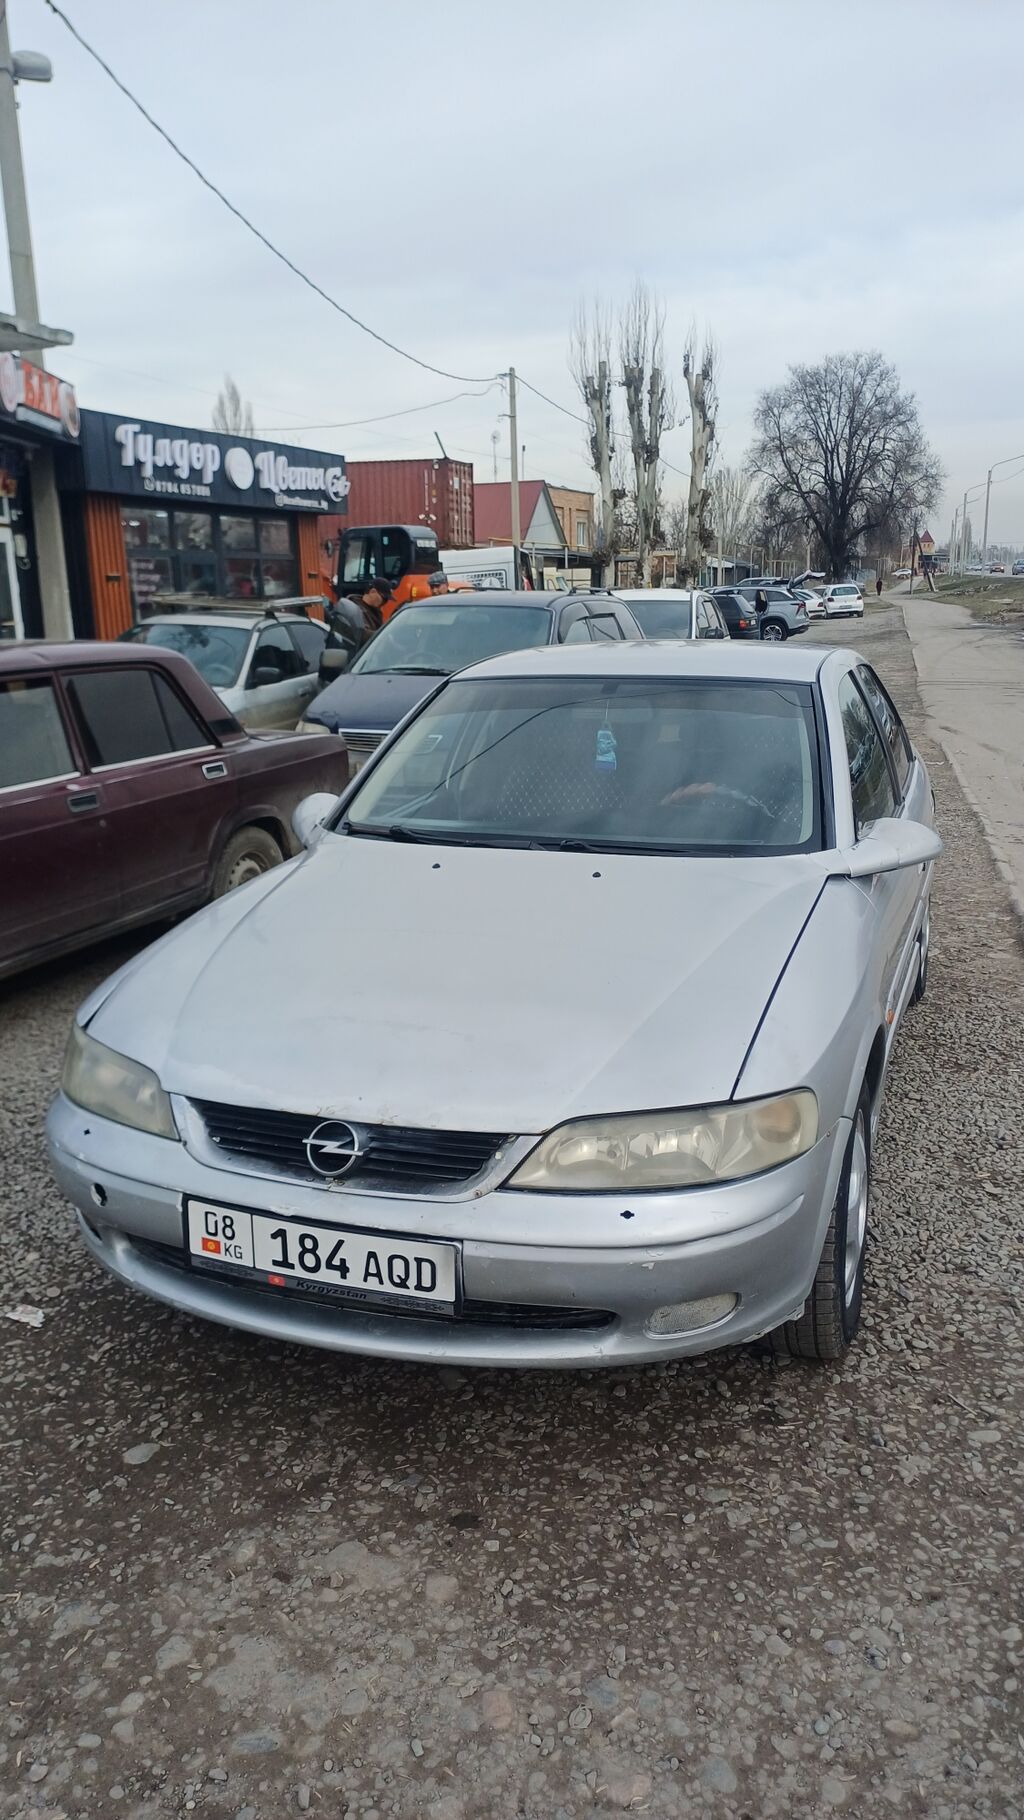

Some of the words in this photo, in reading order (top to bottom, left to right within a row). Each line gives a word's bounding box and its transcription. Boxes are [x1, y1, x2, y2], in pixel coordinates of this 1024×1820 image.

[254, 451, 326, 493] Цветы
[204, 1210, 236, 1241] 08
[270, 1228, 350, 1281] 184
[363, 1251, 437, 1293] AQD
[223, 1242, 243, 1260] KG
[296, 1280, 367, 1300] Kyrgyzstan
